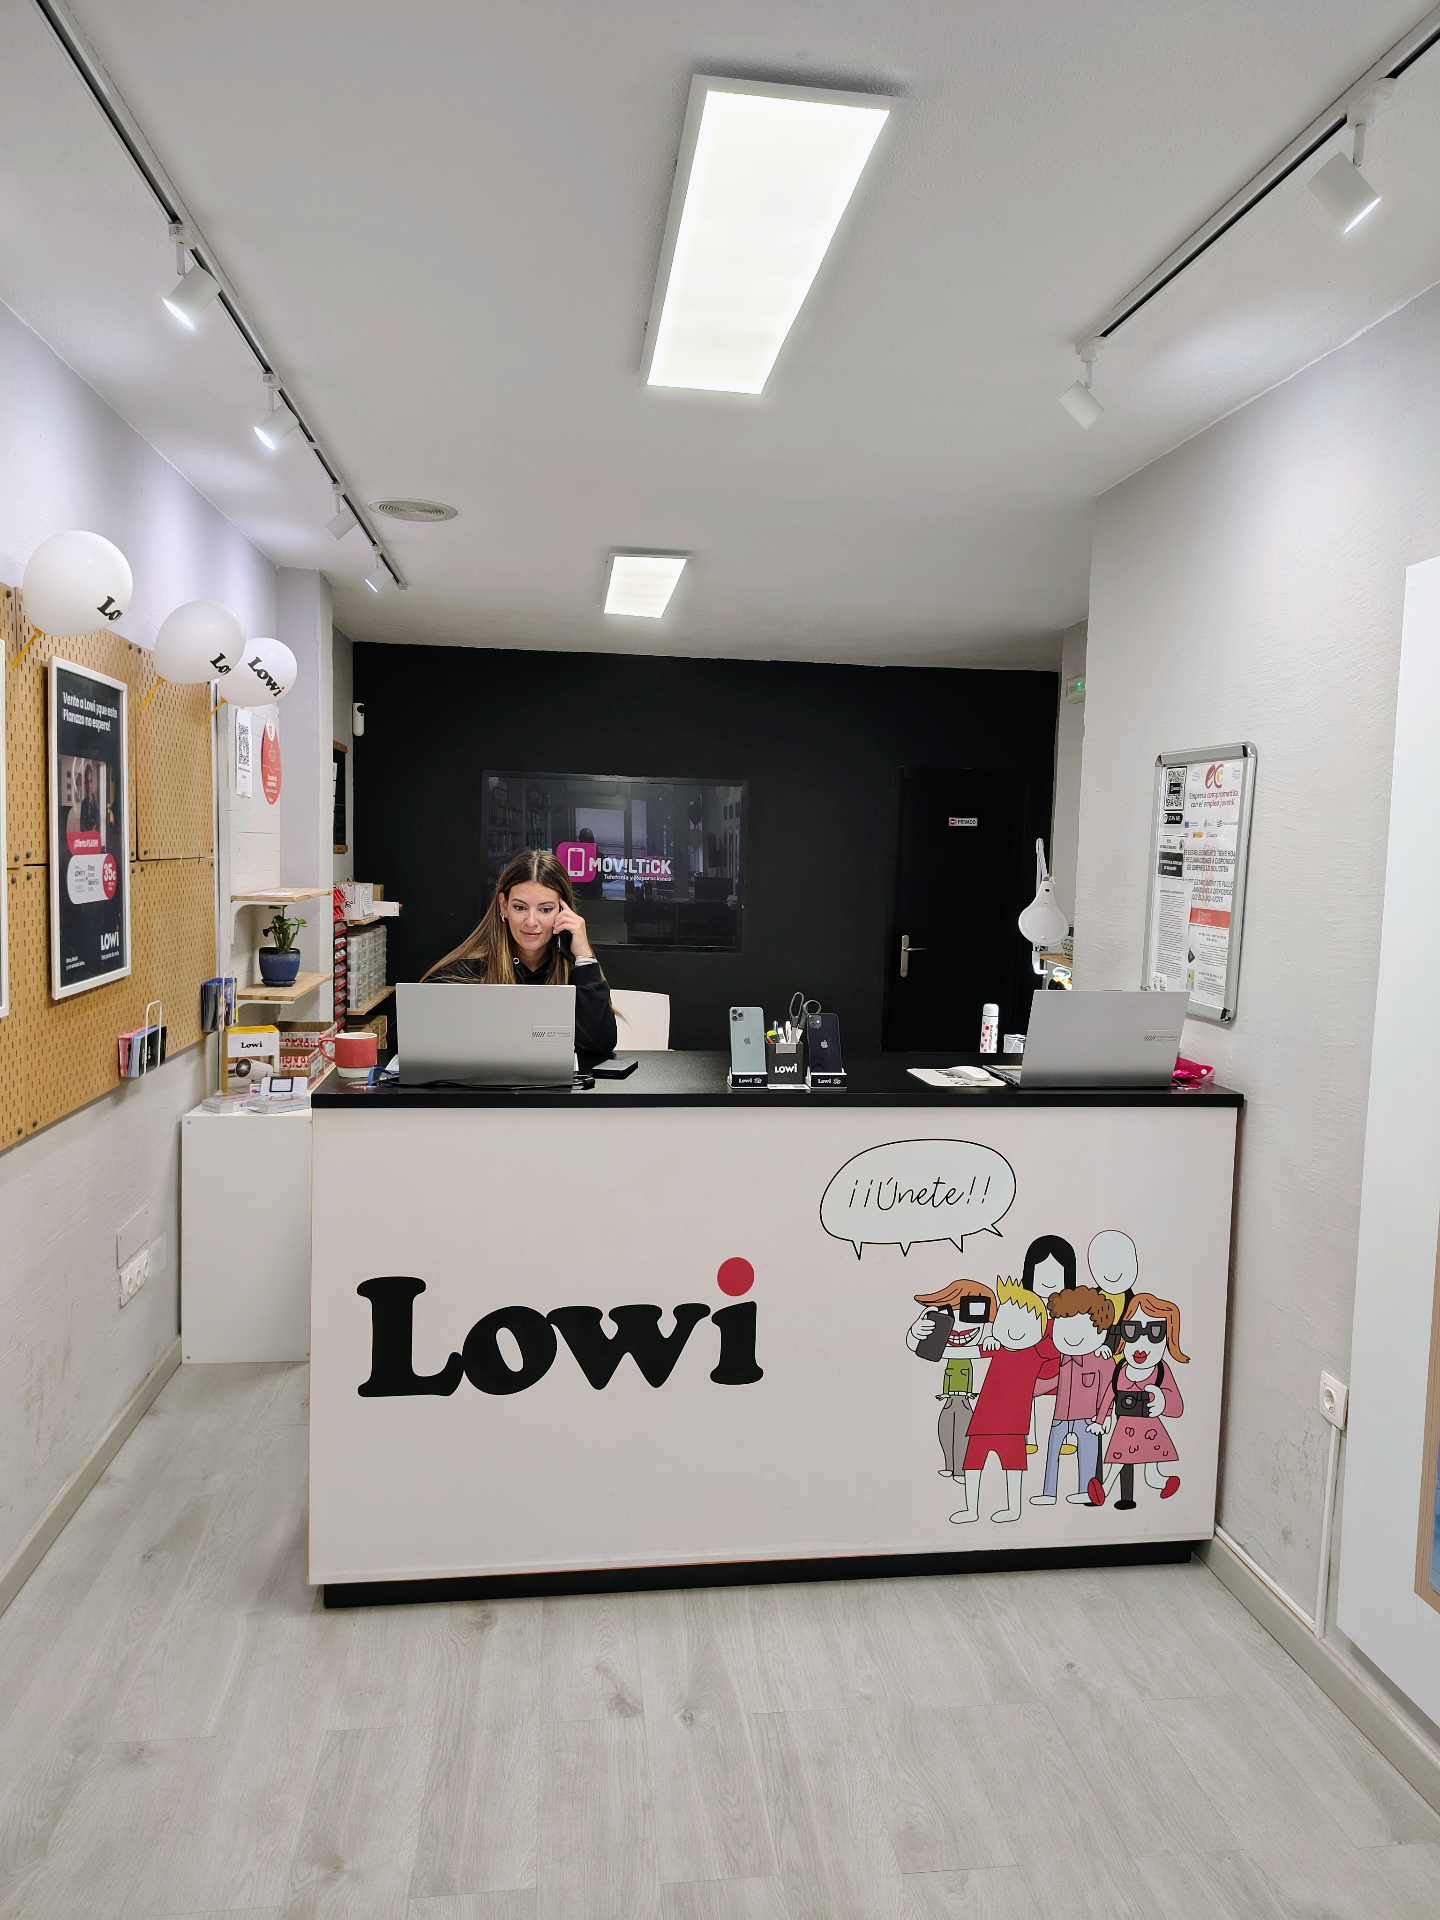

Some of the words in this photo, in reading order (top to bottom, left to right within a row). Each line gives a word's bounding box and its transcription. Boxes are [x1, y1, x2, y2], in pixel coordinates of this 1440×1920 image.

[97, 596, 123, 622] Lo
[210, 653, 231, 675] Lo
[248, 657, 285, 697] Lowi
[63, 692, 79, 707] Vente
[80, 699, 84, 708] a
[84, 698, 96, 712] Lowi
[63, 708, 84, 725] Planazo
[85, 716, 92, 727] no
[92, 719, 111, 732] espera!
[849, 1176, 991, 1210] ¡¡Únete!!
[356, 1257, 764, 1397] Lowi
